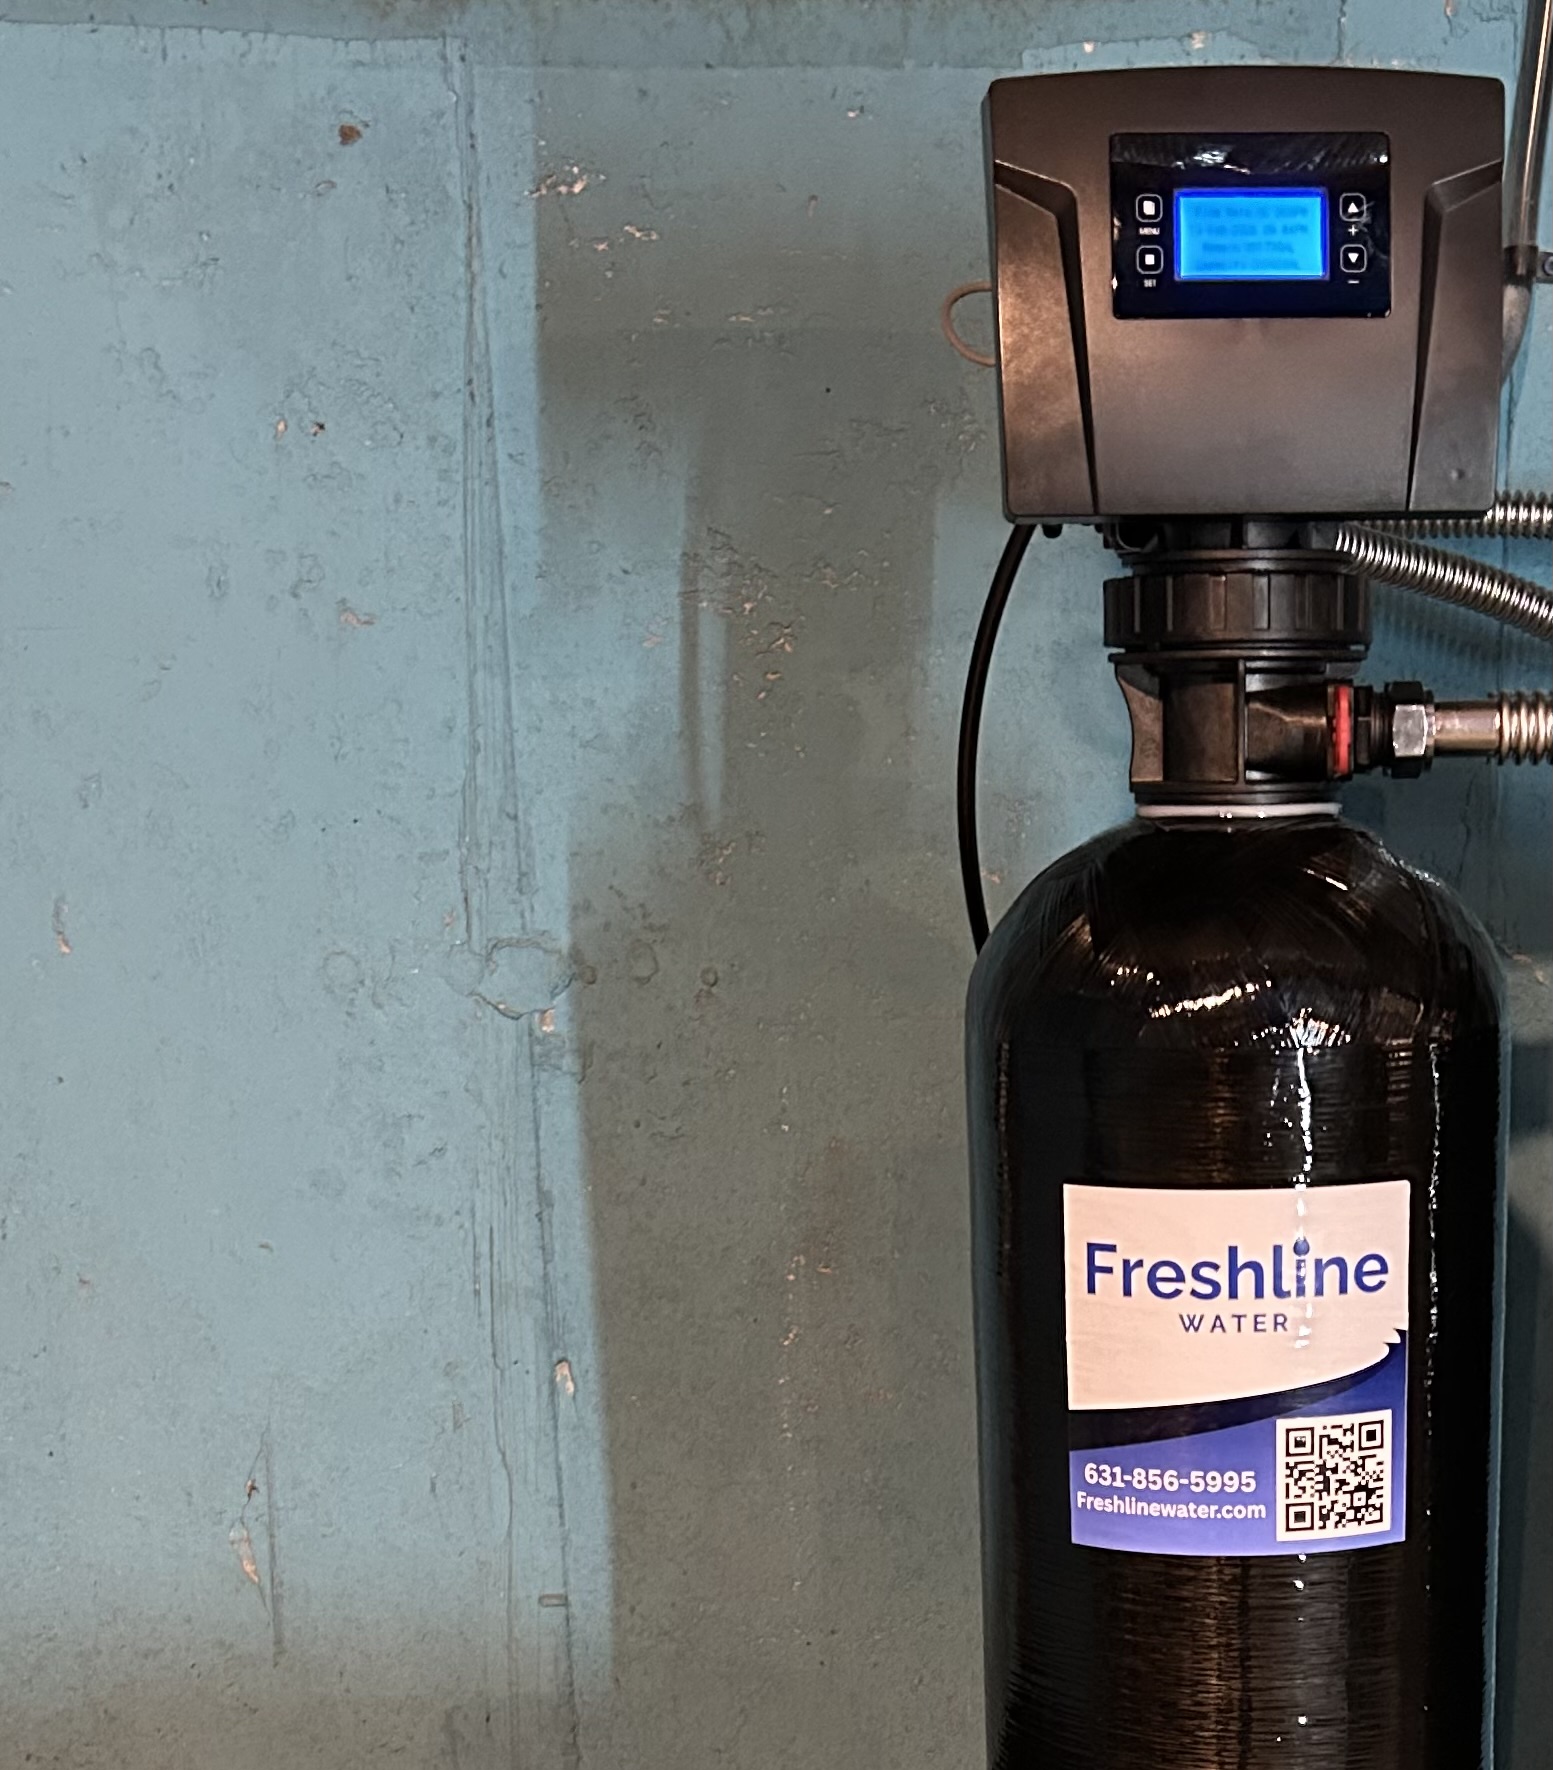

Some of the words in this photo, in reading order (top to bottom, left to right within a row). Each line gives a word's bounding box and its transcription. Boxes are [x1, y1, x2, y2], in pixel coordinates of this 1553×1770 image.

[1138, 226, 1160, 236] MENU
[1143, 278, 1157, 288] SET
[1086, 1236, 1390, 1300] Freshline
[1178, 1312, 1290, 1334] WATER
[1083, 1462, 1257, 1494] 631-856-5995
[1076, 1491, 1267, 1520] Freshlinewater.com
